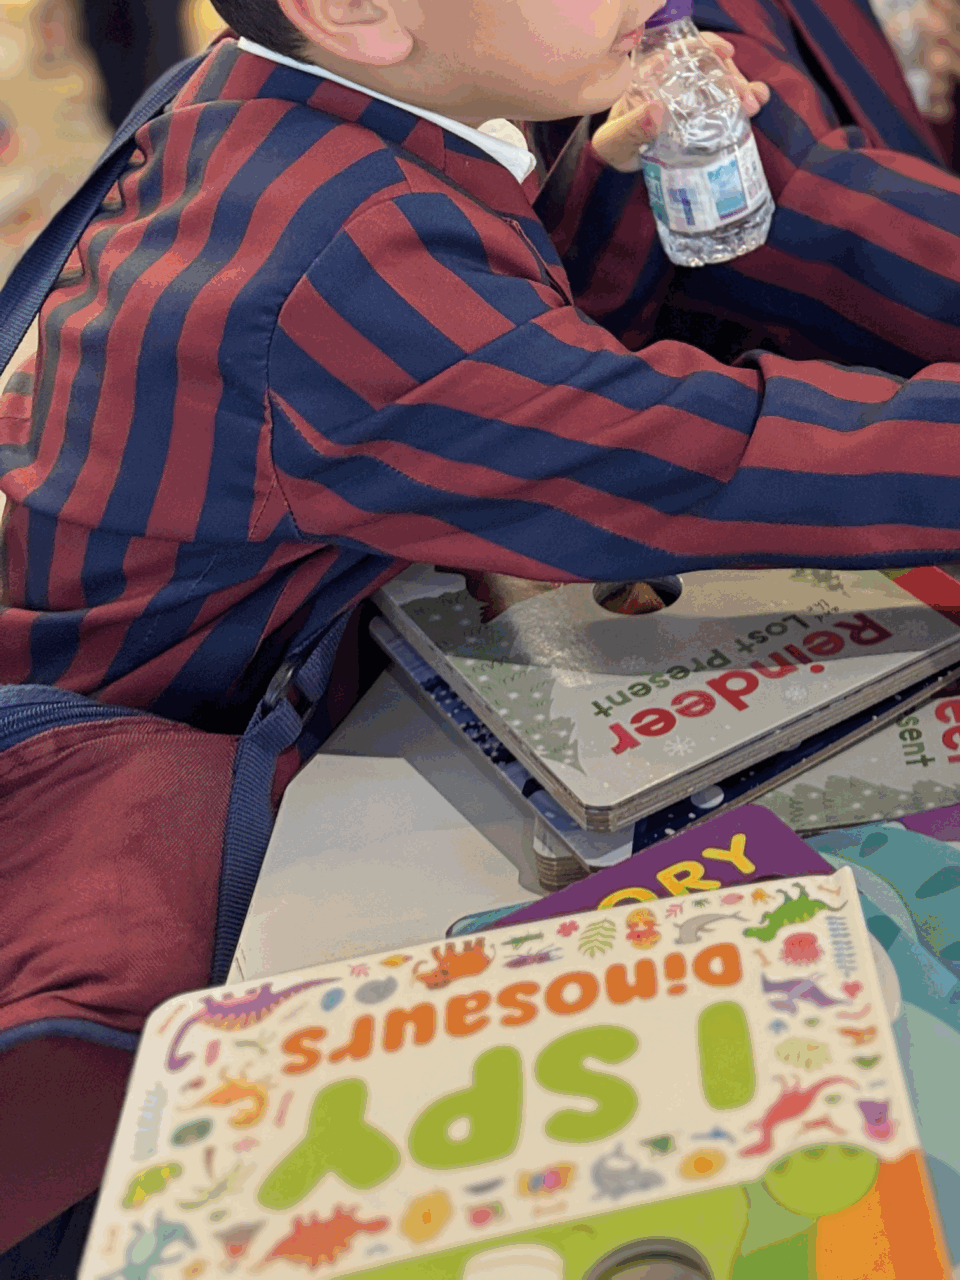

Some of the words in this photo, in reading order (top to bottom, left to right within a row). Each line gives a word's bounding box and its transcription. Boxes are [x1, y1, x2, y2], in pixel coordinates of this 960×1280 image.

[591, 648, 732, 718] Present
[609, 612, 892, 755] Reindeer
[735, 614, 810, 654] Lost
[280, 942, 744, 1077] Dinosaurs
[697, 999, 757, 1112] I
[256, 1023, 640, 1211] SPY
